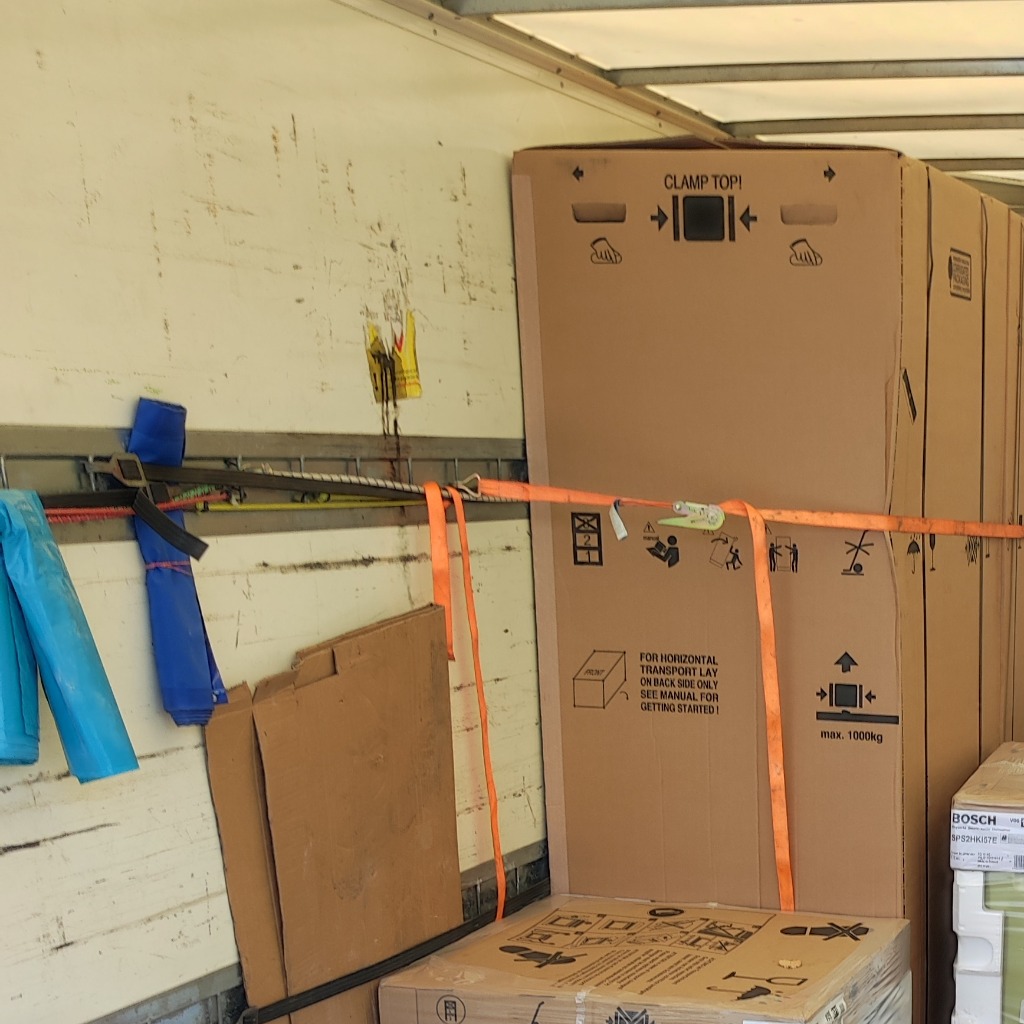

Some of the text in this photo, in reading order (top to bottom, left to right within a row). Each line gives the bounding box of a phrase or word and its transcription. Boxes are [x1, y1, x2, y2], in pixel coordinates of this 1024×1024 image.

[664, 175, 742, 190] CLAMP TOP!
[584, 535, 591, 546] 2
[640, 652, 718, 666] FOR HORIZONTAL
[640, 665, 718, 677] TRANSPORT LAY
[640, 678, 718, 690] ON BACK SIDE ONLY
[640, 690, 719, 702] SEE MANUAL FOR
[641, 703, 675, 713] GETTING
[678, 704, 714, 714] STARTED
[820, 730, 883, 743] max. 1000kg
[952, 813, 996, 825] BOSCH
